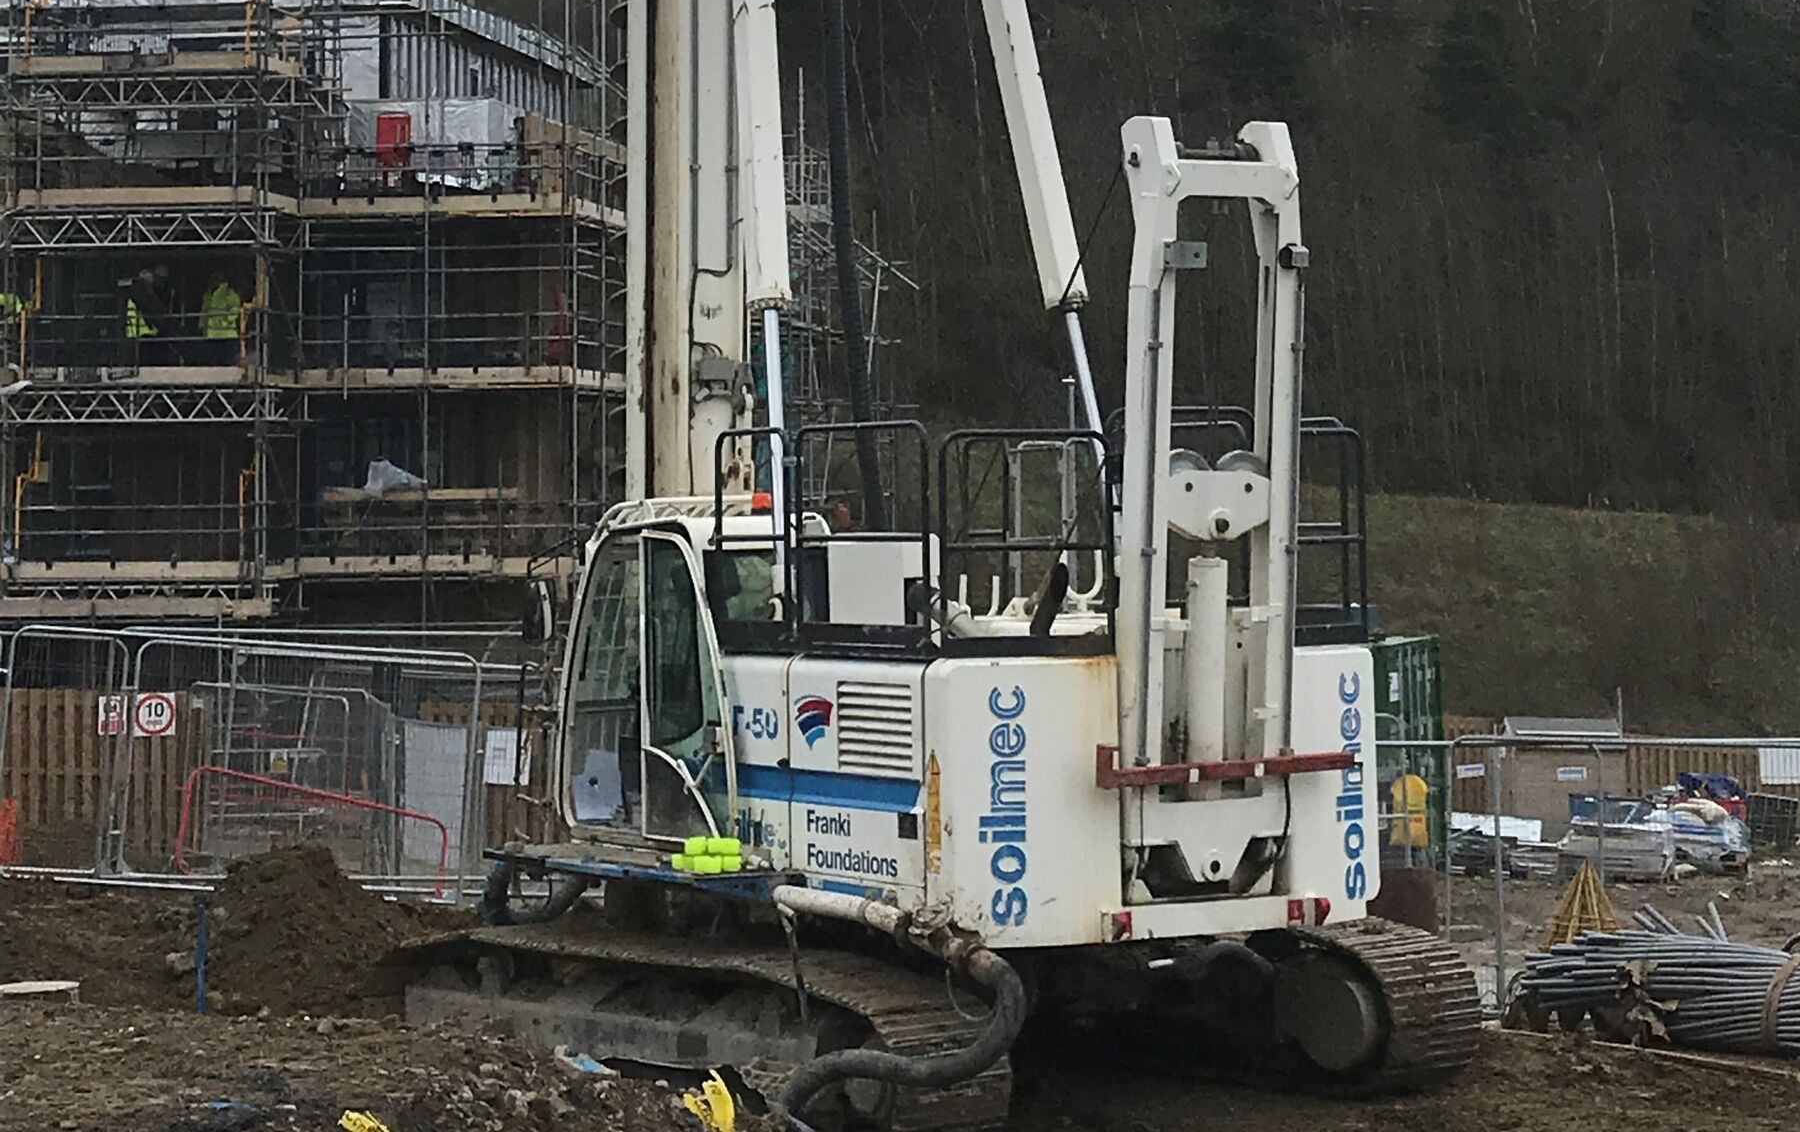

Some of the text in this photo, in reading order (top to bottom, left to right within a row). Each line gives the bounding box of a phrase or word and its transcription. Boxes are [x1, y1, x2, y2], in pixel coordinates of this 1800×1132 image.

[145, 702, 164, 717] 10
[1336, 671, 1366, 899] soilmec
[806, 809, 851, 837] Franki
[979, 685, 1027, 926] soilmec
[807, 843, 898, 878] Foundations
